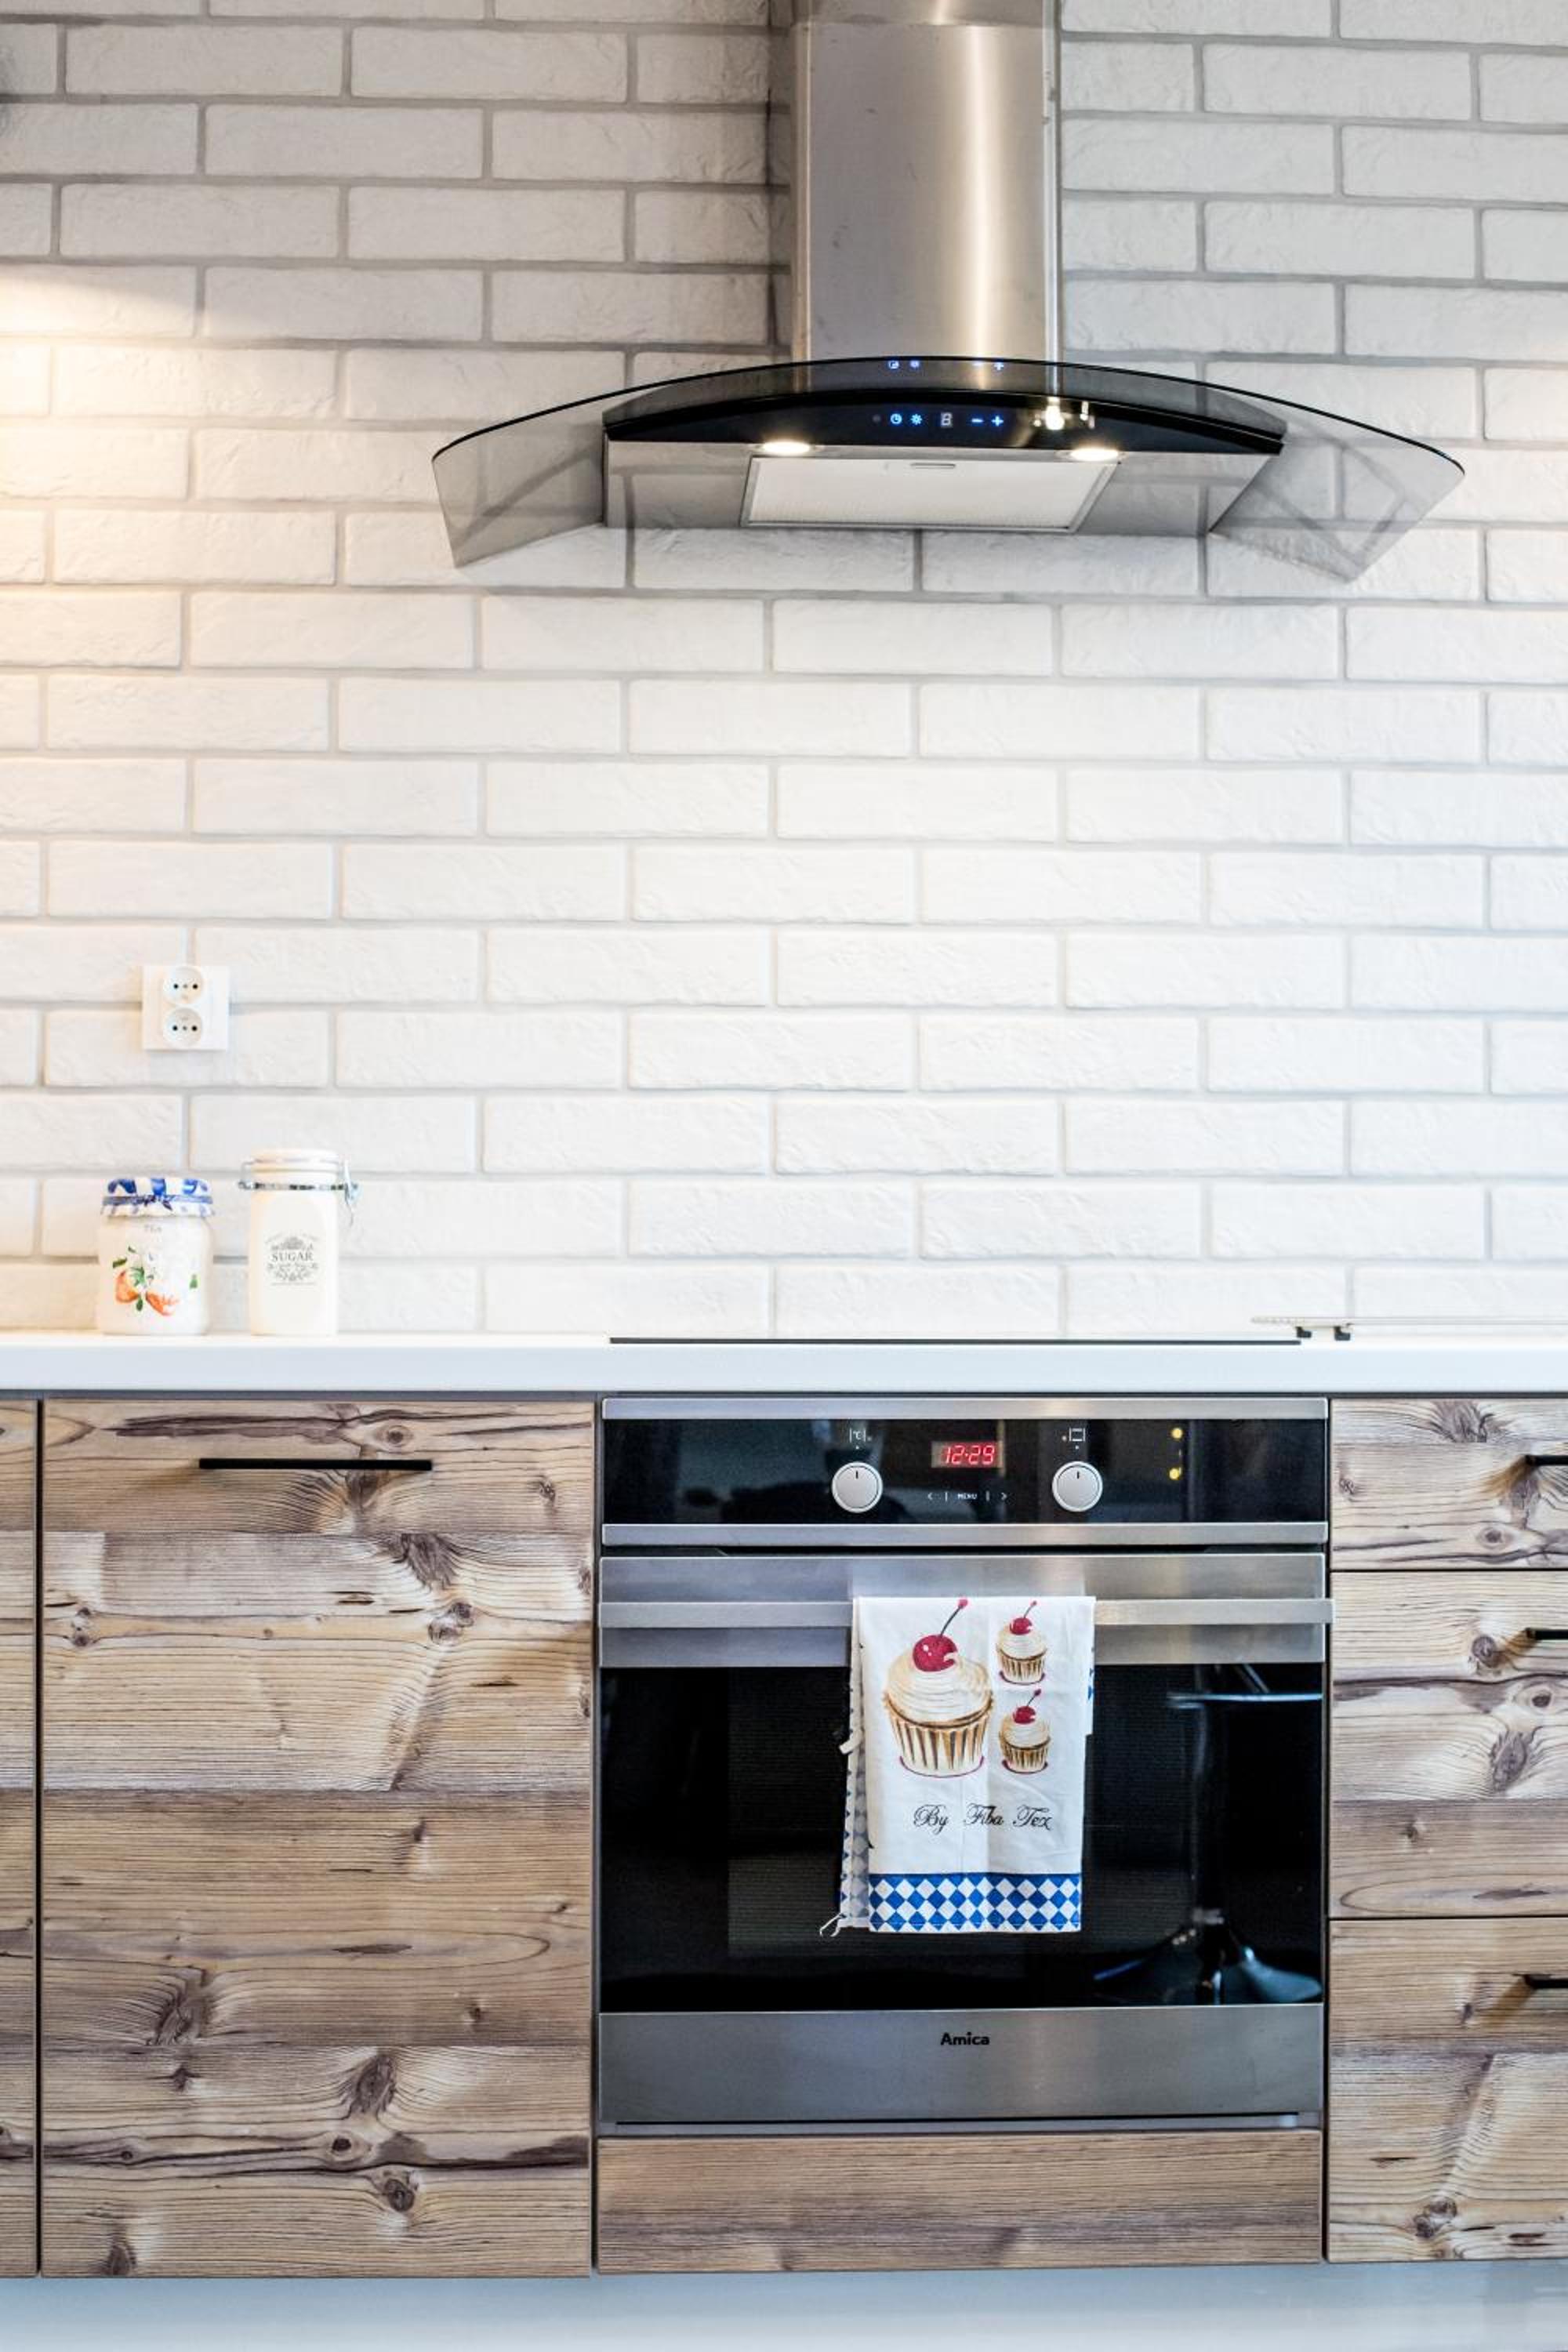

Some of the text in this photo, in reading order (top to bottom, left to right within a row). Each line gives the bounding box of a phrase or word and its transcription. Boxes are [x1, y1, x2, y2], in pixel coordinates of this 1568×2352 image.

[271, 1251, 314, 1261] SUGAR
[913, 1804, 949, 1835] By
[1012, 1804, 1052, 1831] Tex
[941, 2031, 990, 2045] Amica
